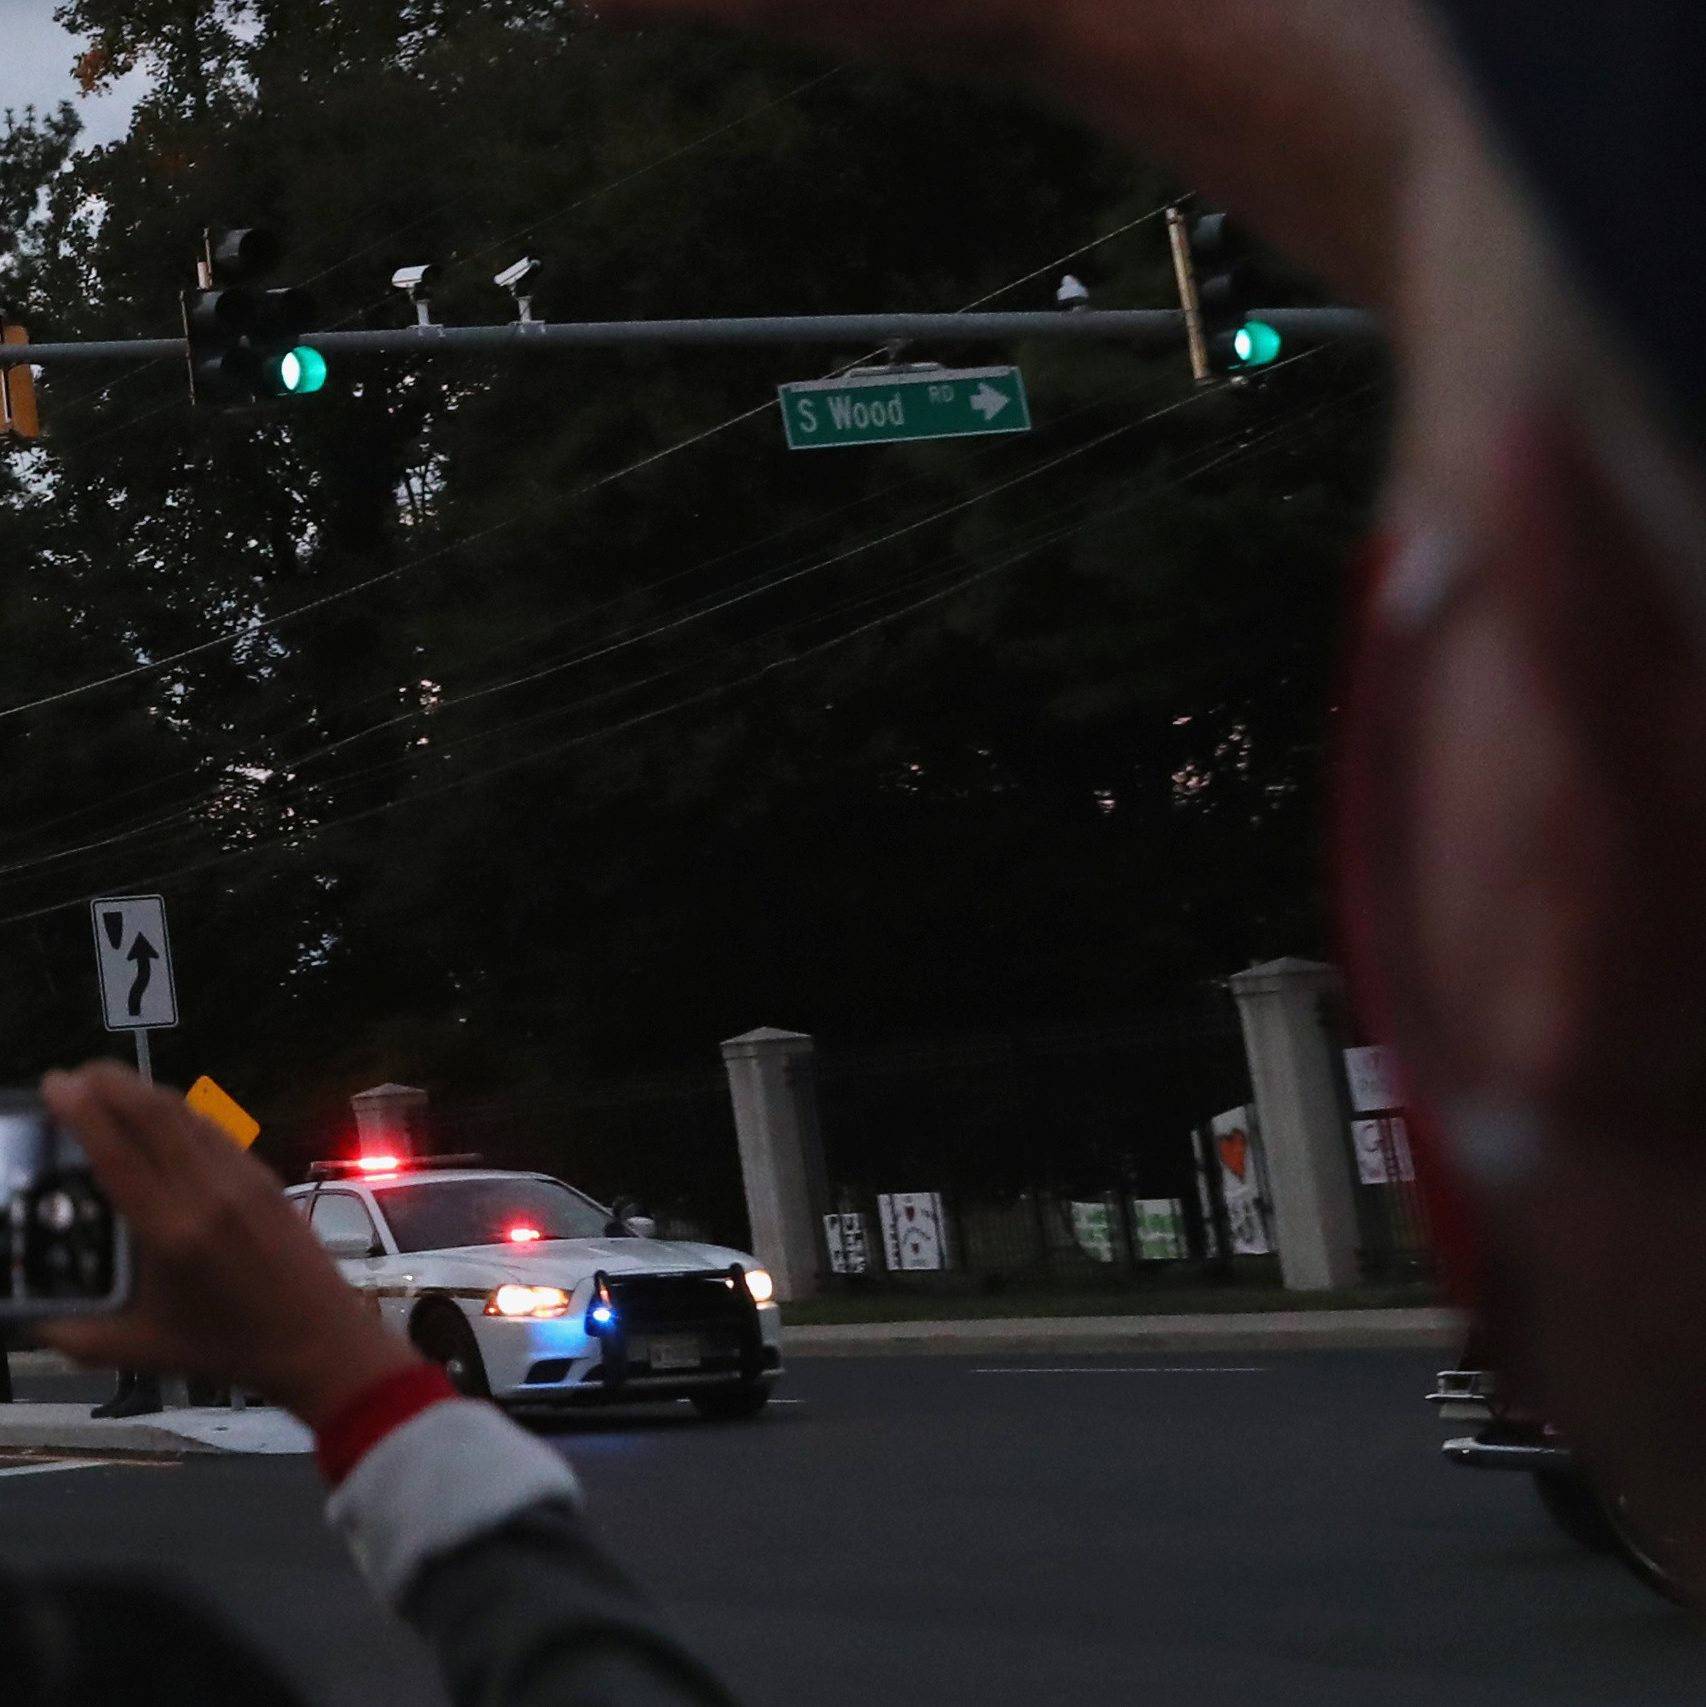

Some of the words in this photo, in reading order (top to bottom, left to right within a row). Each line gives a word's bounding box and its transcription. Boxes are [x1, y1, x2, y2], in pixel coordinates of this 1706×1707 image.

[797, 398, 818, 433] S
[827, 392, 905, 430] Wood
[928, 385, 955, 403] RD
